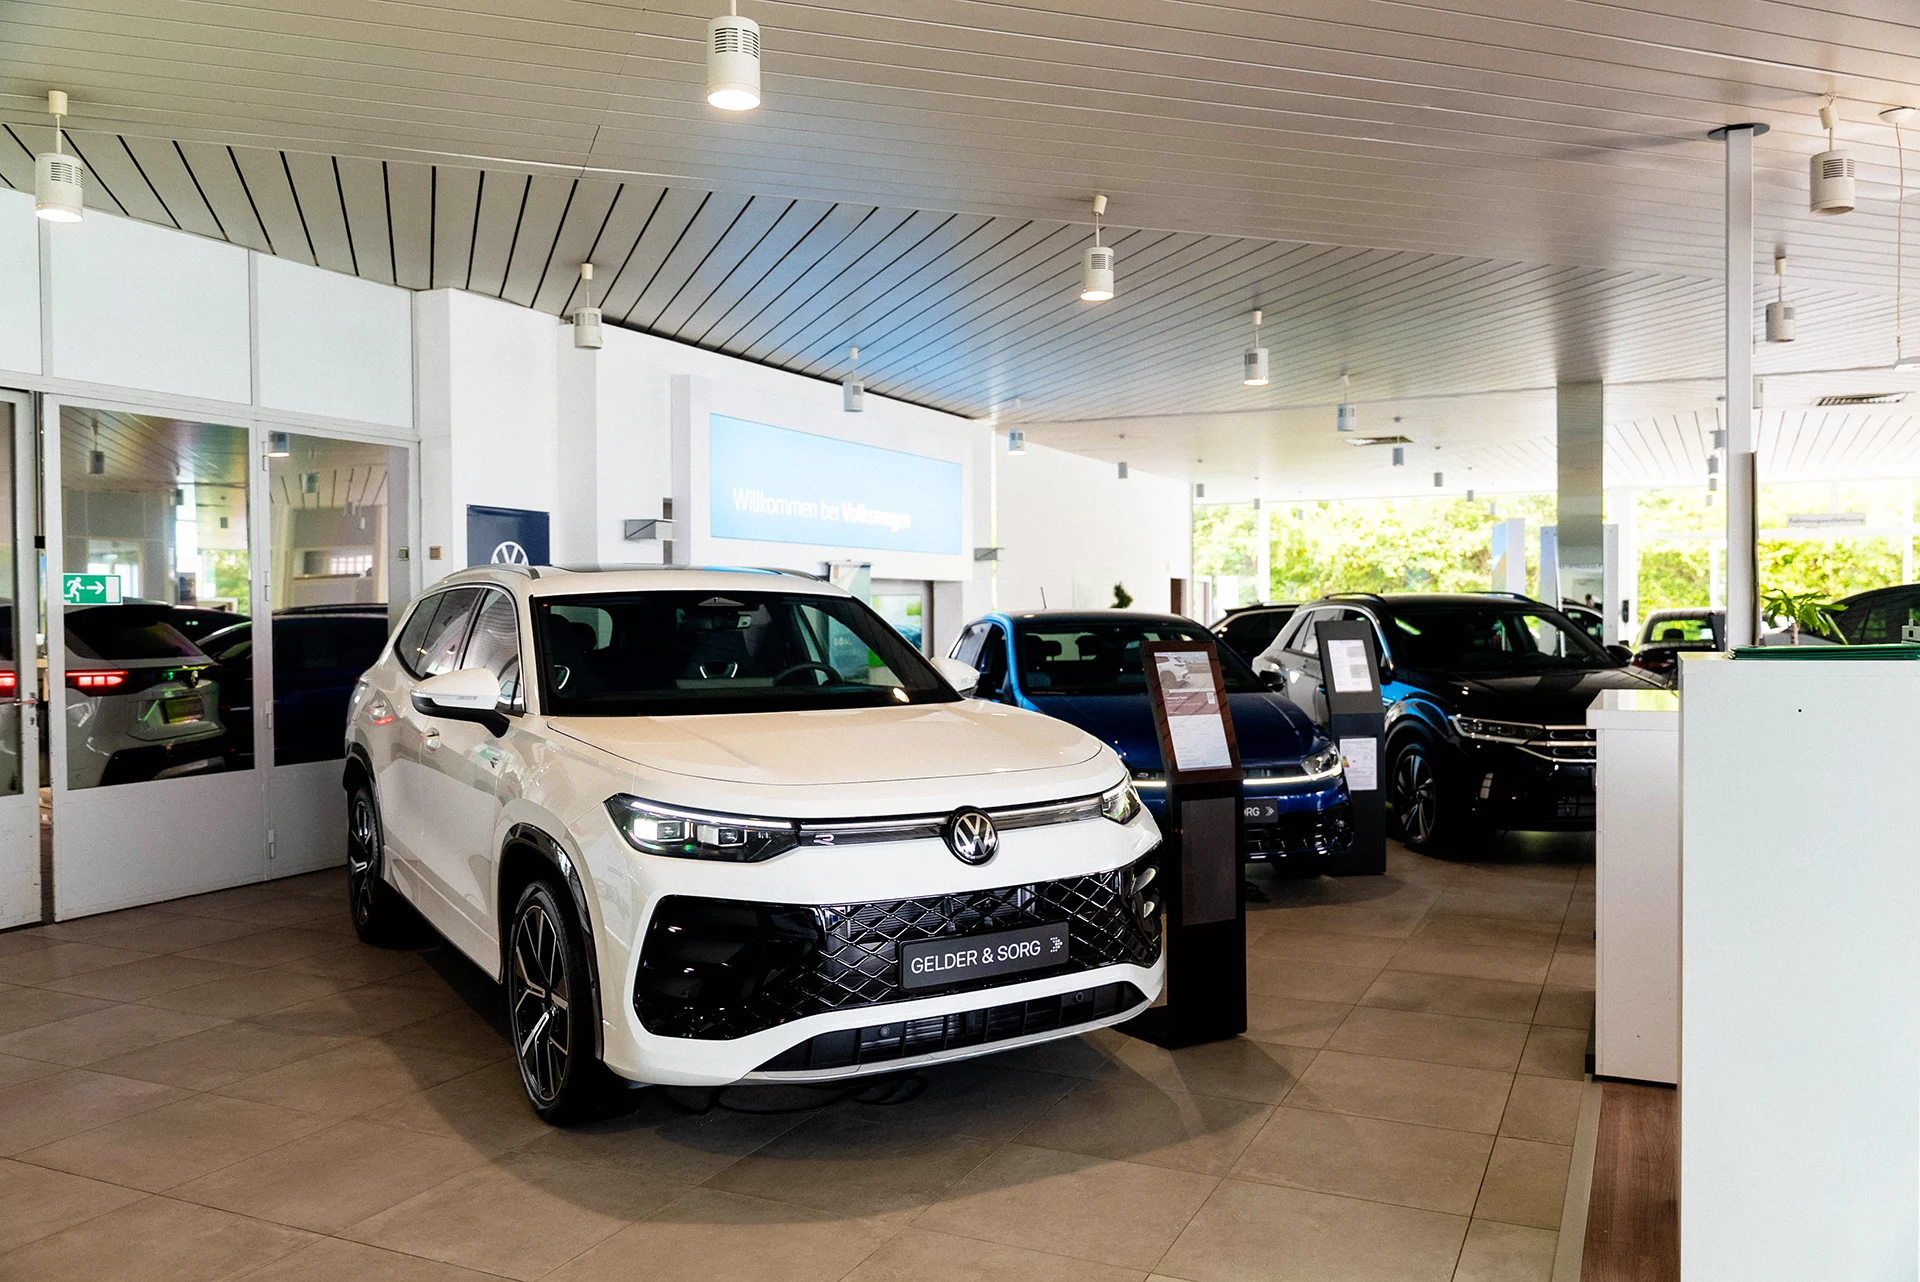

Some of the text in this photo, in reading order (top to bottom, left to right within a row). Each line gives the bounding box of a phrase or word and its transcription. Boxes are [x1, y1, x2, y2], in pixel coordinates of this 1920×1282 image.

[732, 487, 912, 533] Willkommen bei Volkswagen
[911, 940, 1041, 974] GELDER & SORG
